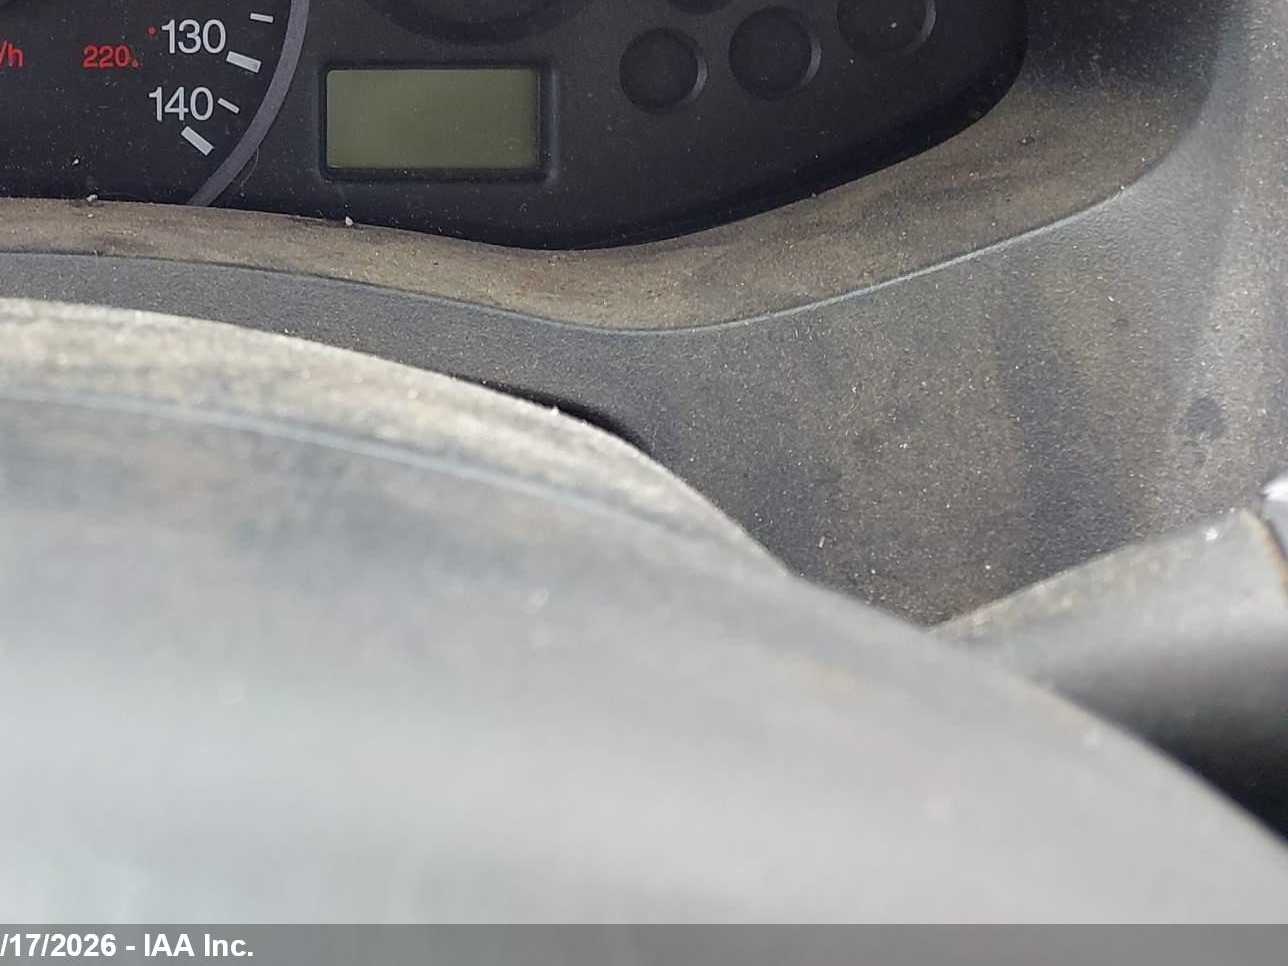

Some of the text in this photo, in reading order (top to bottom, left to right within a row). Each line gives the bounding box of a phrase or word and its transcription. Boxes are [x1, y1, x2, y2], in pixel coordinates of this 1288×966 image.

[161, 19, 226, 54] 130
[83, 45, 128, 68] 220
[147, 85, 213, 121] 140
